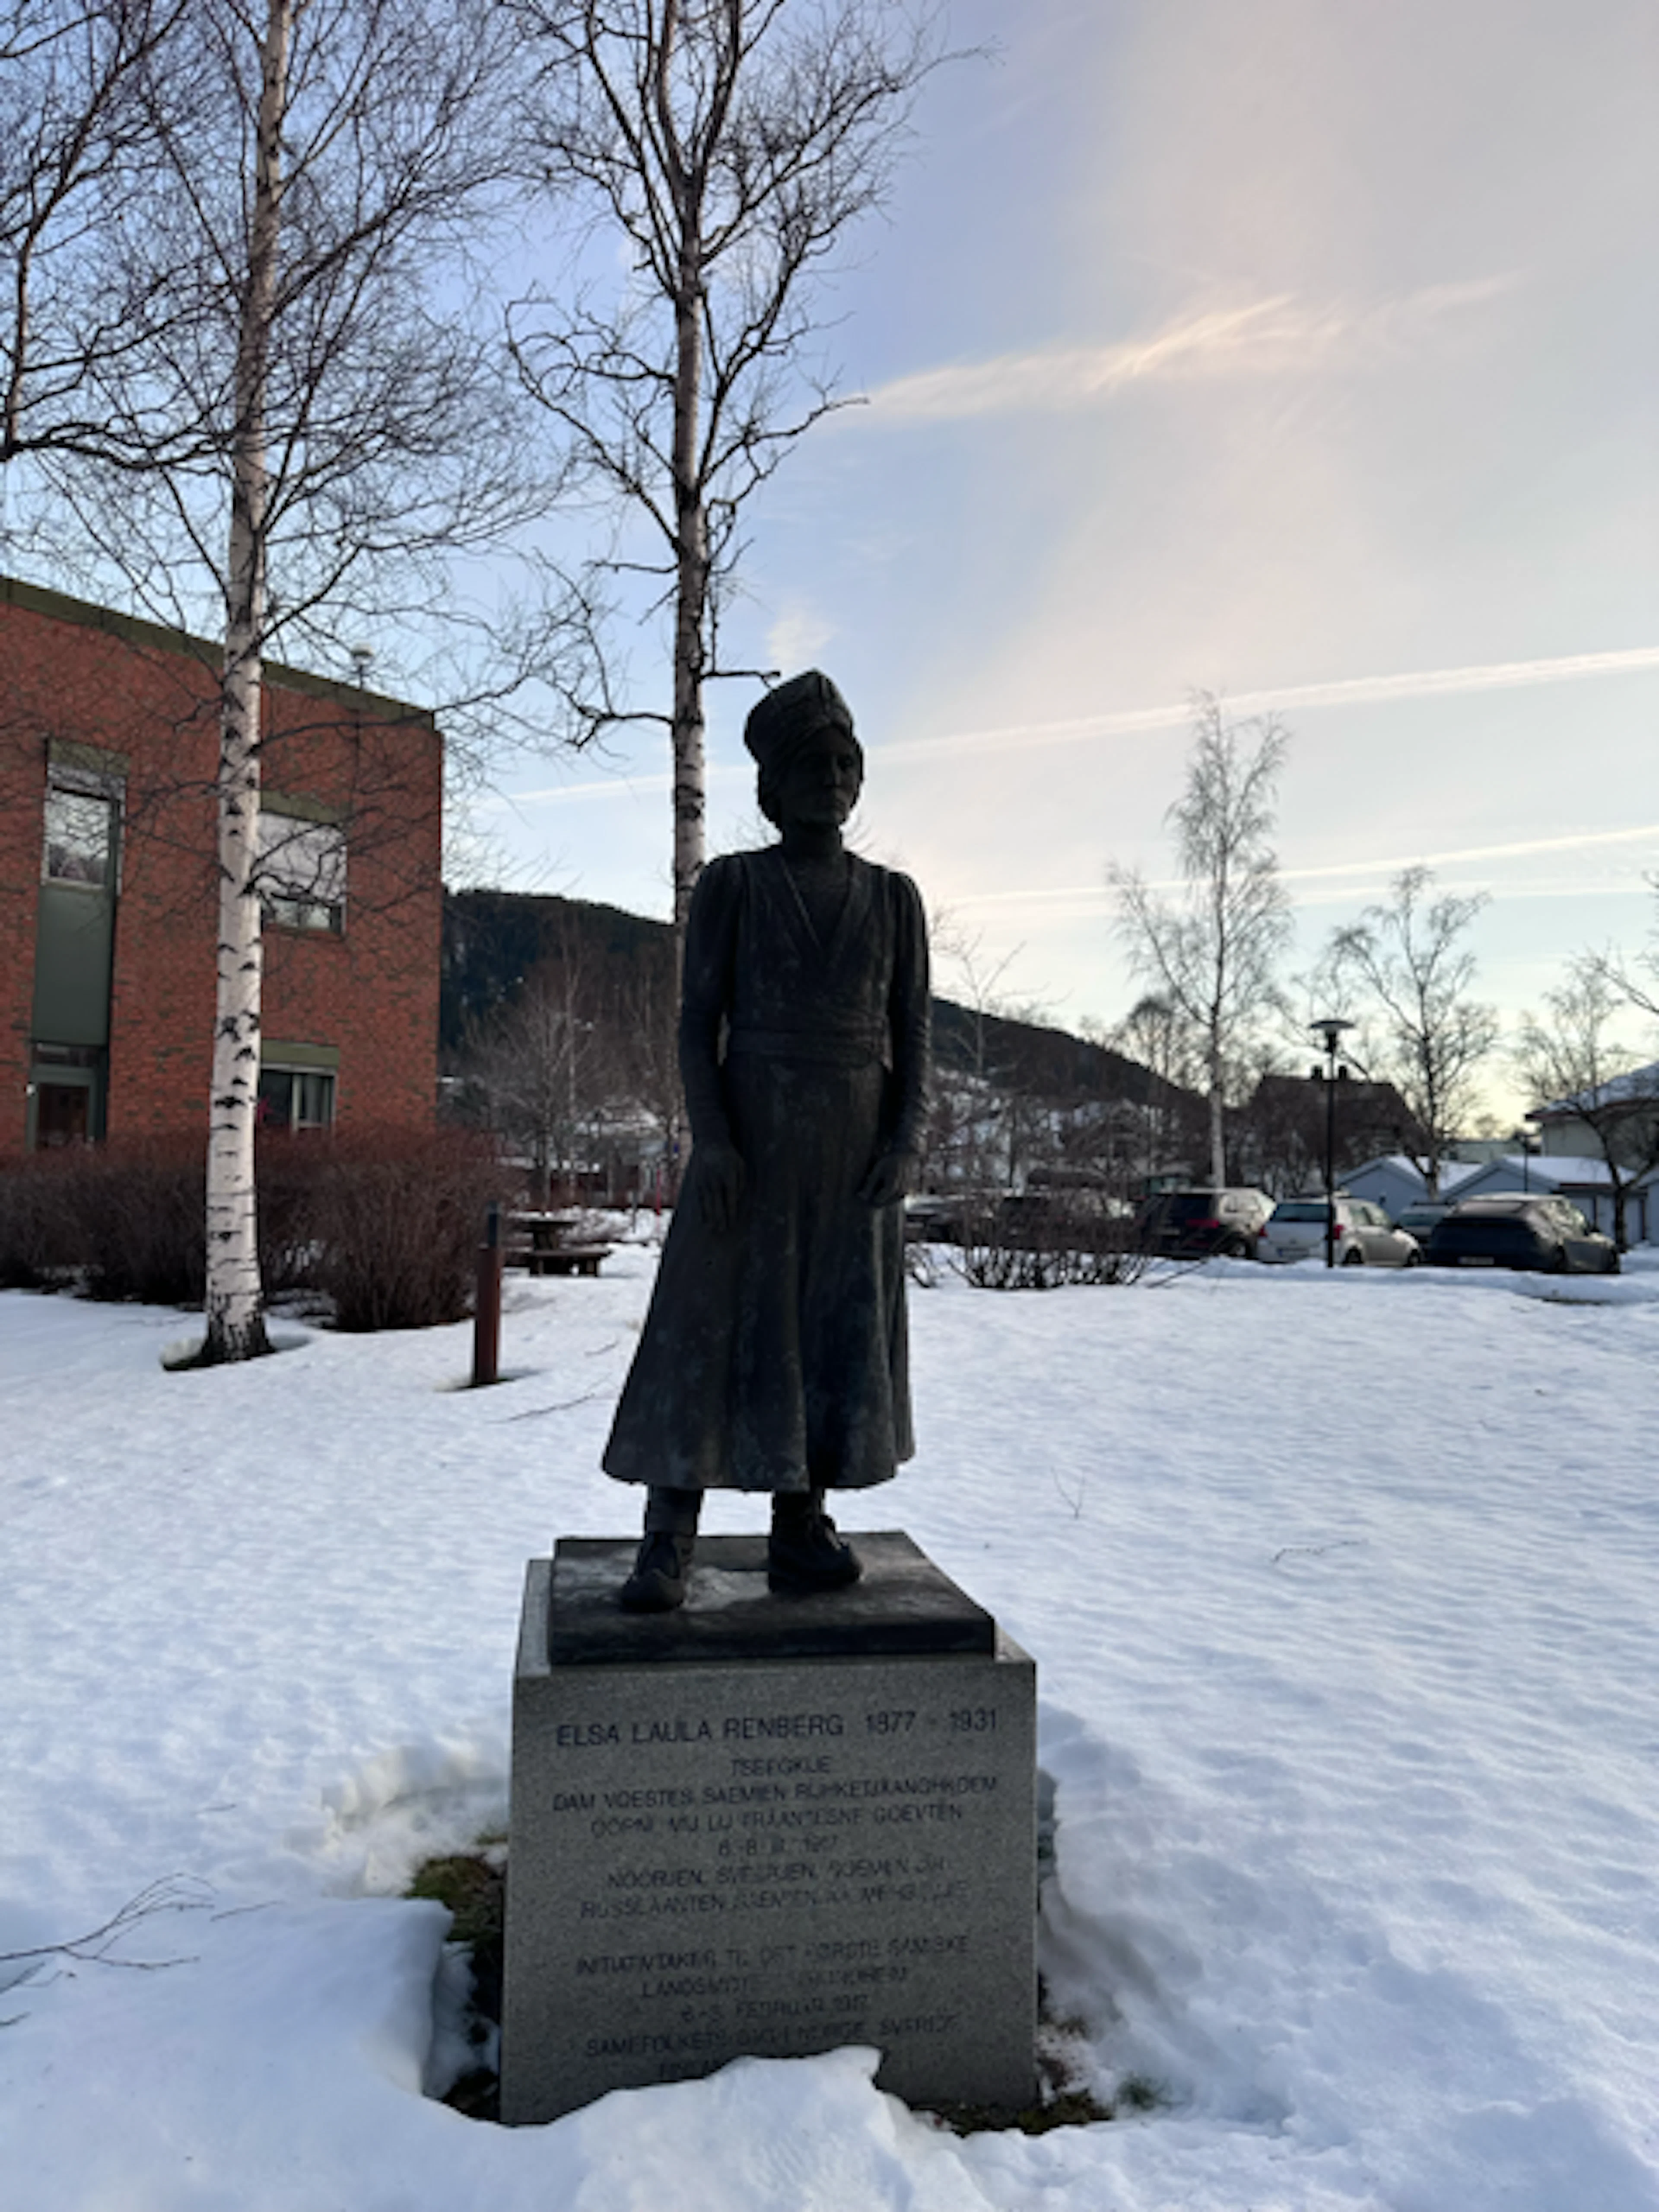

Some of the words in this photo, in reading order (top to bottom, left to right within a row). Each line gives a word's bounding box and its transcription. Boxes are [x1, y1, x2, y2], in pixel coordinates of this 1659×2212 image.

[556, 1724, 620, 1746] ELSA
[632, 1719, 712, 1742] LAULA
[722, 1713, 844, 1739] RENBERG
[950, 1707, 996, 1731] 1931
